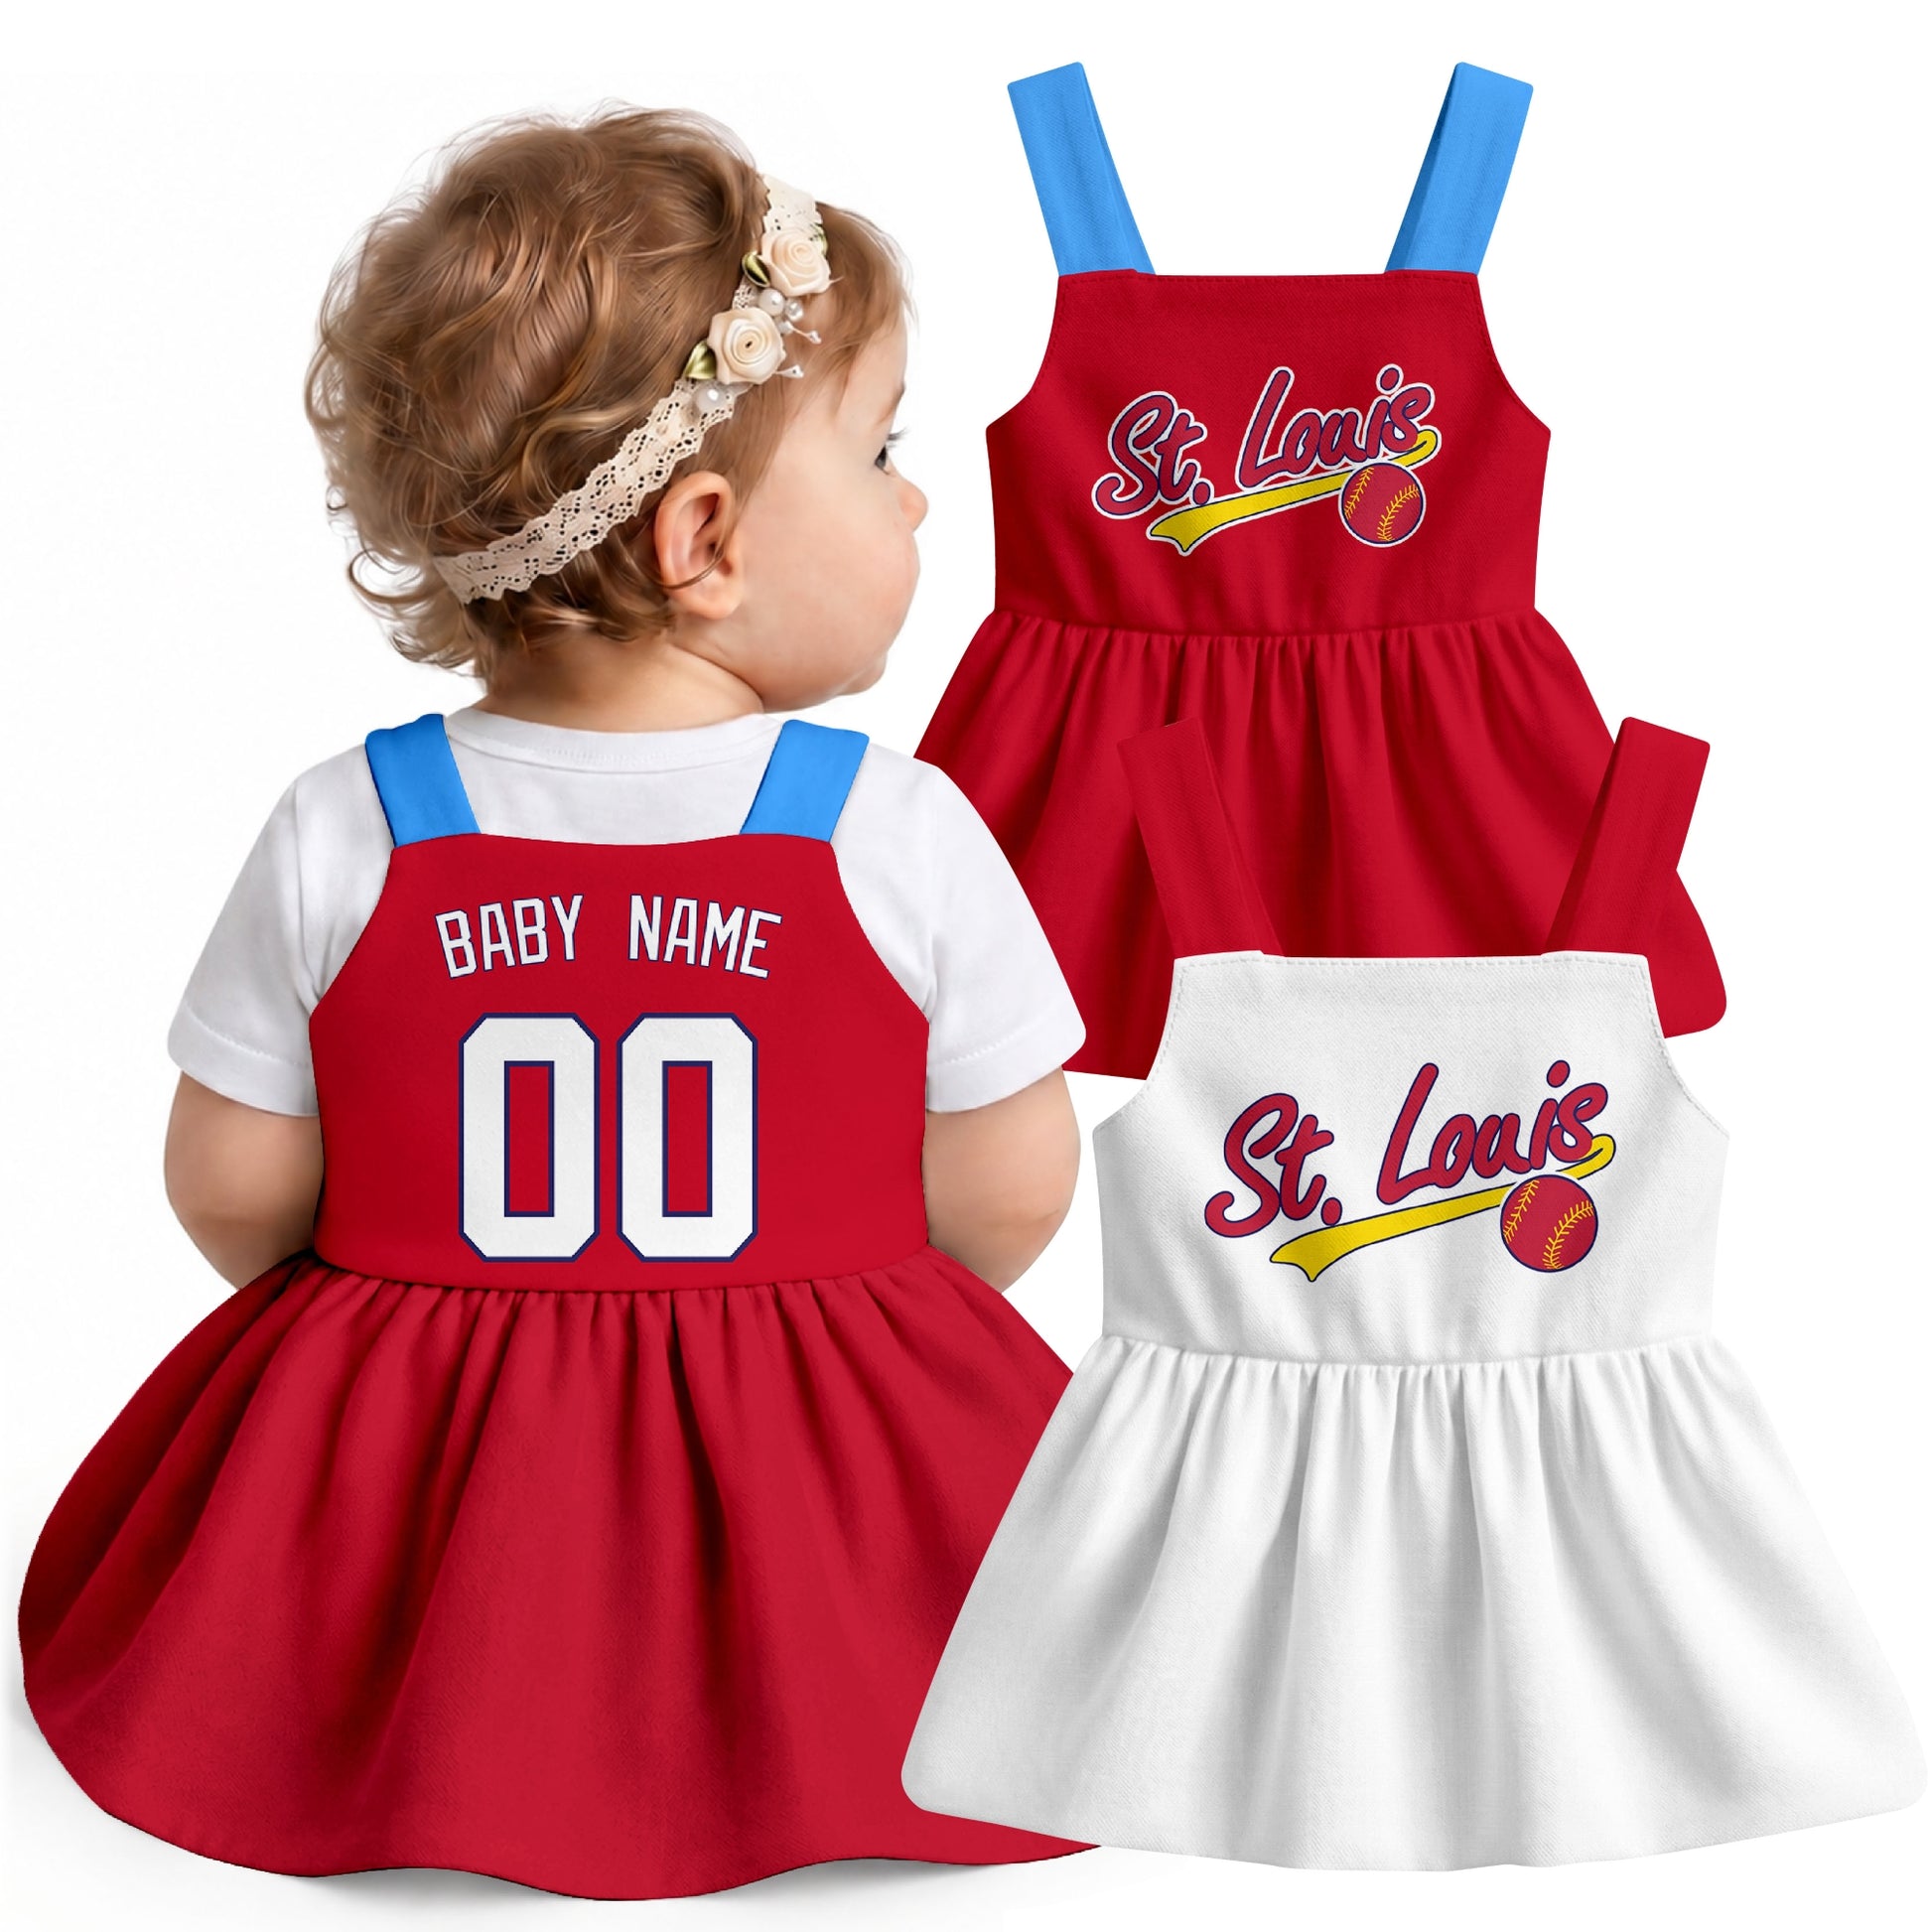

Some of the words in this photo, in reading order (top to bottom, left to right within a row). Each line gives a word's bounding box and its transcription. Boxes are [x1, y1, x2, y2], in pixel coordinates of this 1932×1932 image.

[1094, 393, 1212, 516] St.
[1237, 365, 1434, 489] Louis
[435, 895, 584, 980] BABY
[627, 895, 782, 980] NAME
[459, 1013, 758, 1262] 00
[1204, 1092, 1342, 1238] St.
[1376, 1059, 1608, 1205] Louis
